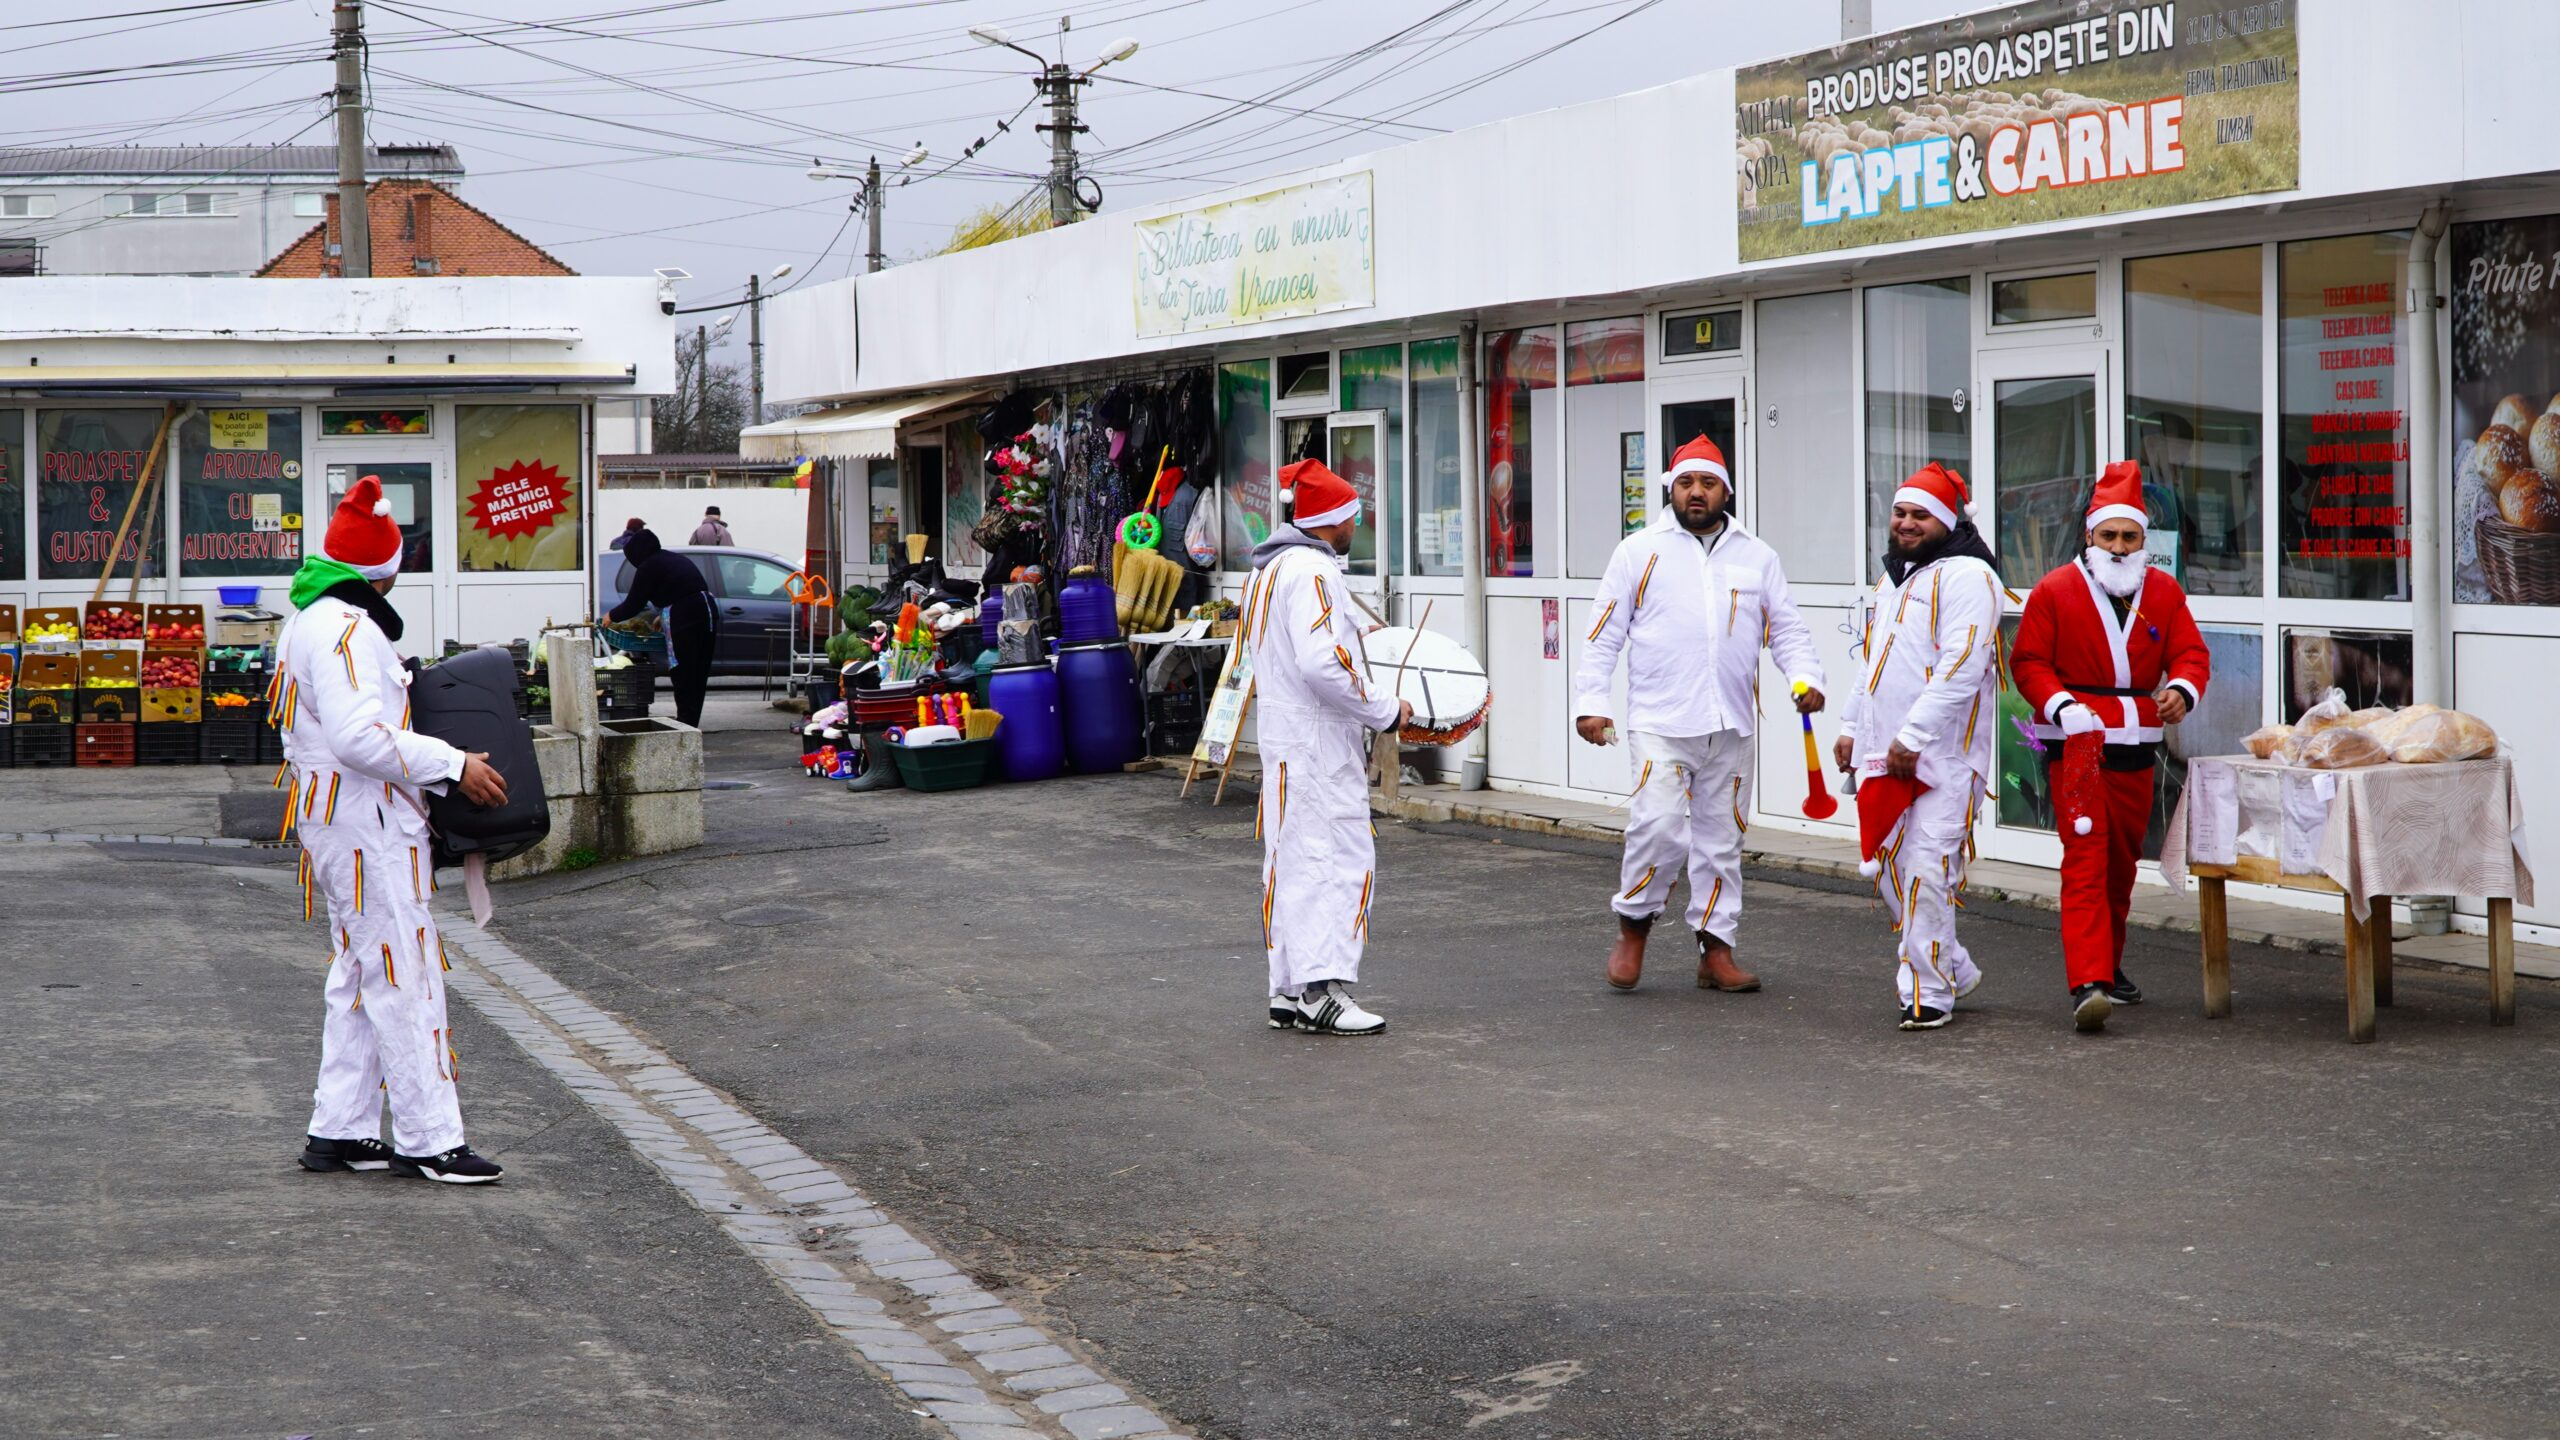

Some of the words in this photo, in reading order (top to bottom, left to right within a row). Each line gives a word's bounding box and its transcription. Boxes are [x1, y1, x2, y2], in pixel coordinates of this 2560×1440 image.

[1806, 54, 1929, 120] PRODUSE
[1934, 15, 2110, 94] PROASPETE
[2117, 2, 2175, 57] DIN
[1738, 96, 1794, 136] MIHAI
[1745, 154, 1790, 192] SOPA
[1801, 136, 1952, 228] LAPTE
[1954, 132, 1987, 203] &
[1987, 94, 2186, 198] CARNE
[1151, 219, 1243, 276] Biblioteca
[1255, 224, 1281, 253] cu
[1292, 200, 1352, 247] vinuri
[1158, 277, 1181, 310] din
[1240, 262, 1319, 317] Vrancei
[2323, 287, 2365, 307] TELEMEA
[2321, 318, 2365, 338] TELEMEA
[2319, 349, 2362, 370] TELEMEA
[1953, 393, 1964, 408] 49
[227, 412, 250, 421] AICI
[202, 452, 282, 480] APROZAR
[487, 496, 515, 513] MAI
[517, 485, 550, 504] MICI
[493, 478, 531, 497] CELE
[89, 486, 110, 522] &
[229, 492, 253, 519] CU
[183, 531, 300, 560] AUTOSERVIRE
[2147, 553, 2173, 566] SCHIS
